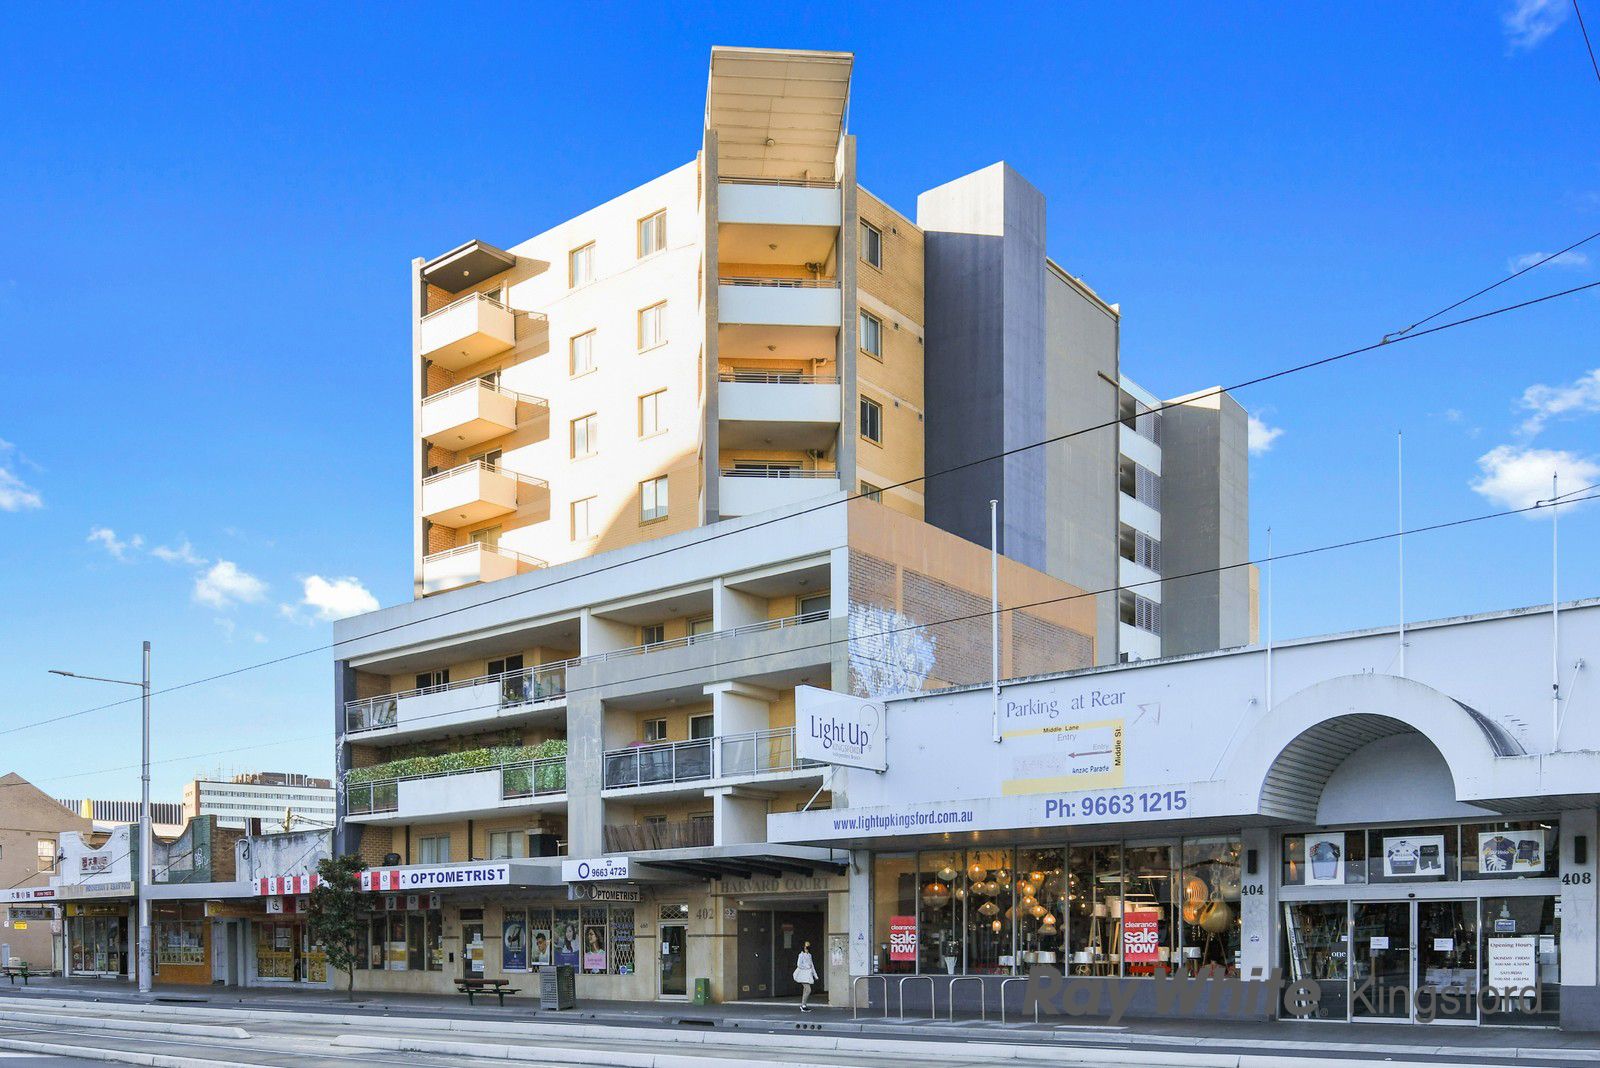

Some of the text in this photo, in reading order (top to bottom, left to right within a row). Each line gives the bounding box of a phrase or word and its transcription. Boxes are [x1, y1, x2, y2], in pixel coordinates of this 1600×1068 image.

[1006, 691, 1125, 718] Parking at Rear
[811, 715, 869, 755] Light Up
[1057, 734, 1076, 742] Entry
[1045, 790, 1188, 818] Ph: 9663 1215
[833, 809, 973, 831] www.lightupkingsford.com.au
[410, 868, 506, 885] OPTOMETRIST
[592, 866, 627, 878] 9663 4729
[1561, 872, 1591, 886] 408
[721, 876, 829, 893] HARVARD COURT
[1241, 884, 1264, 896] 404
[588, 884, 638, 901] OPTOMETRIST
[697, 908, 714, 920] 402
[890, 930, 917, 944] sale
[1124, 927, 1159, 944] sale
[891, 944, 915, 953] now
[1125, 943, 1155, 954] now
